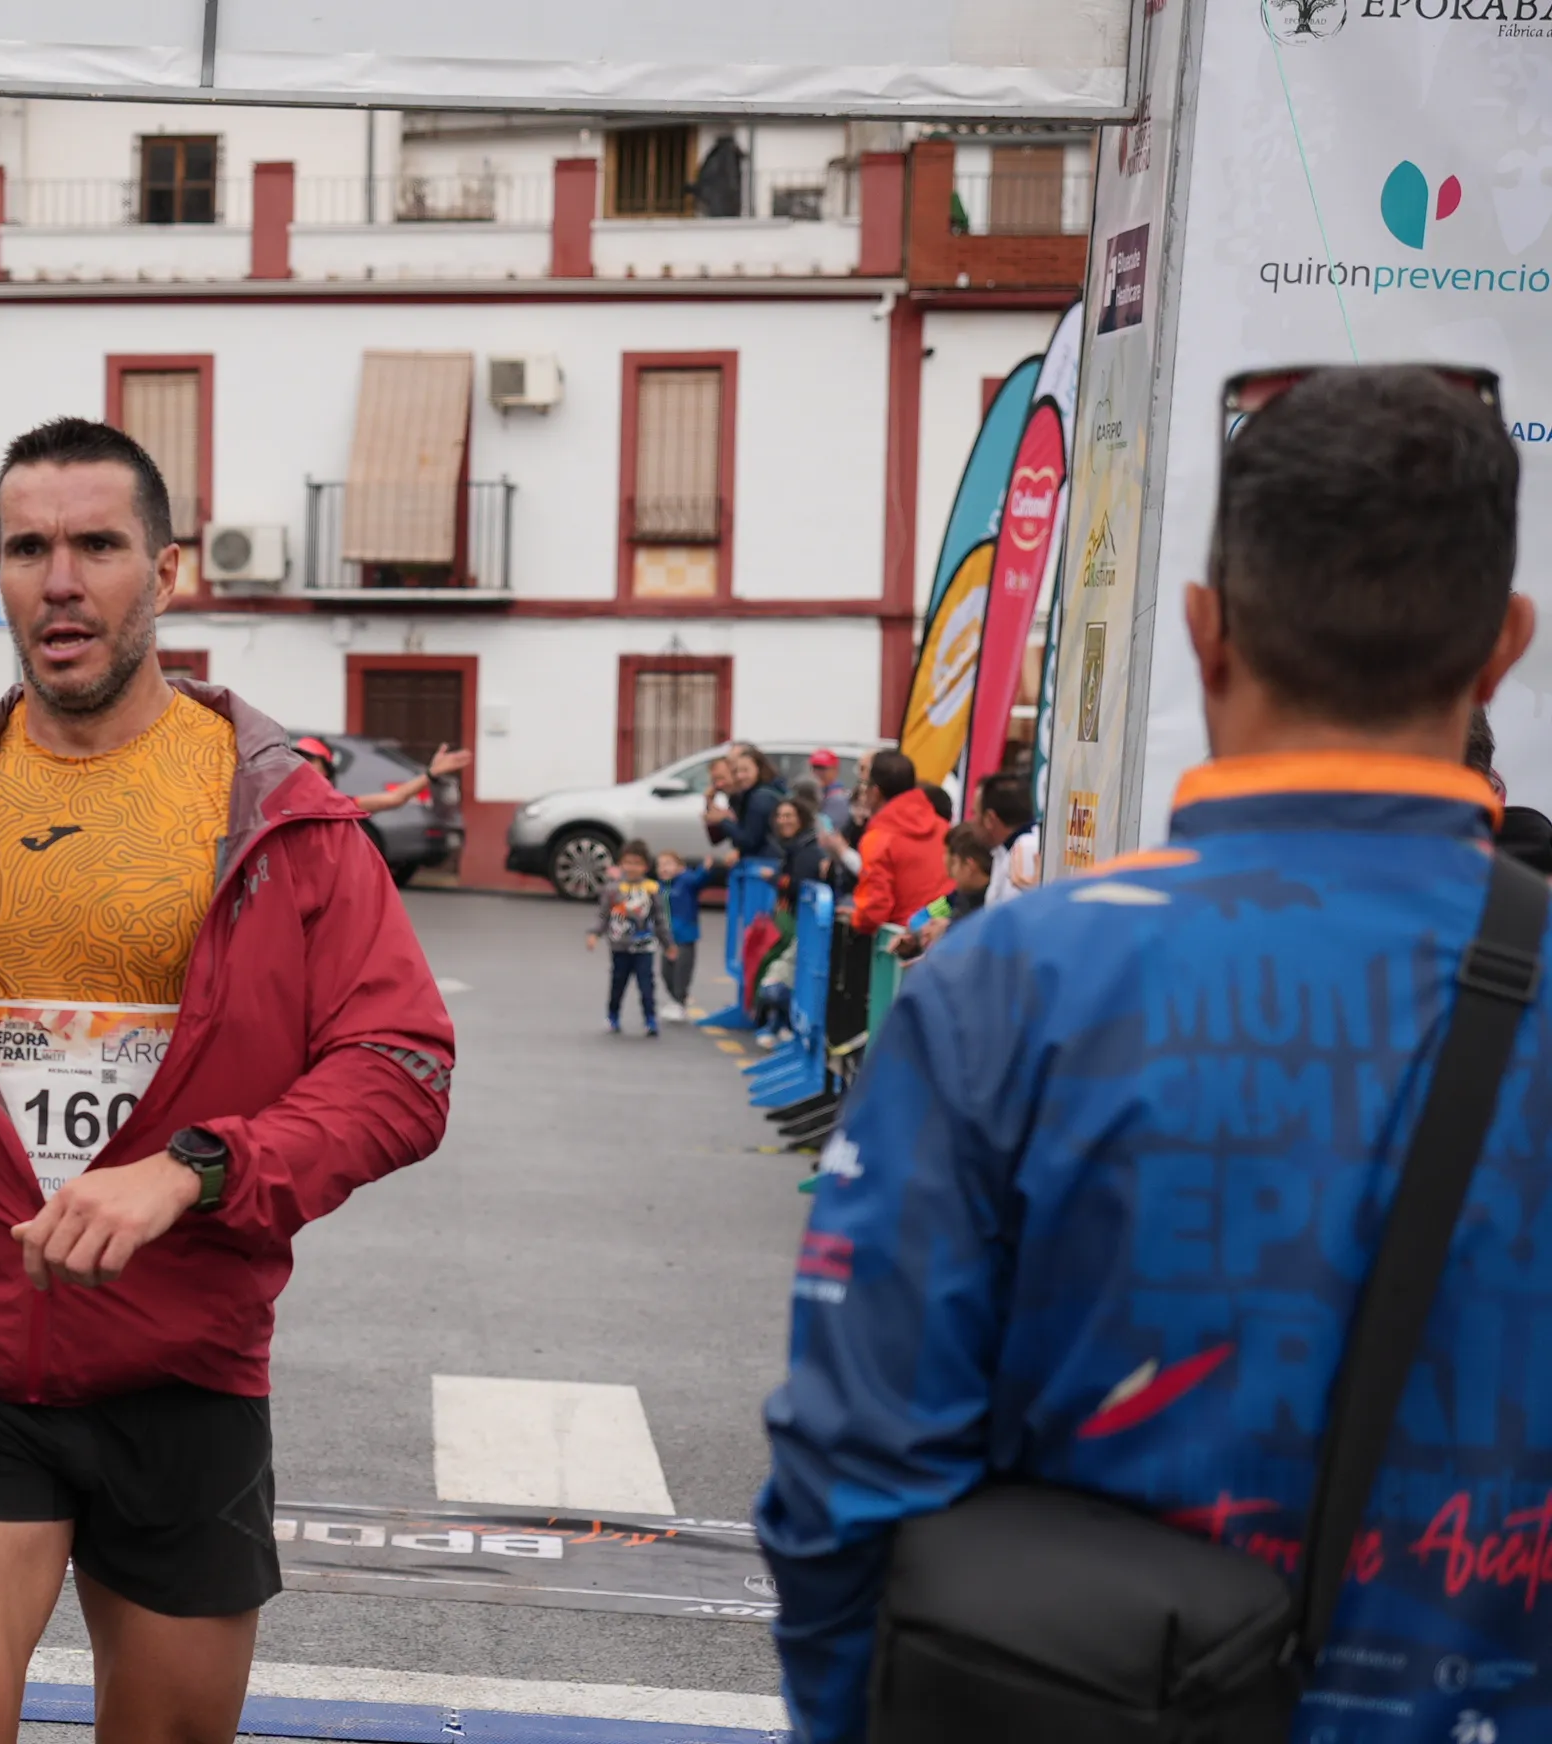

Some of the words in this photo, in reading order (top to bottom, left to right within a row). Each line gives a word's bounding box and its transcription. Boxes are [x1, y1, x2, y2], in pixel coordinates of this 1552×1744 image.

[1498, 24, 1544, 39] Fábrica
[1096, 419, 1122, 442] CARPIO
[37, 1151, 93, 1162] MARTINEZ
